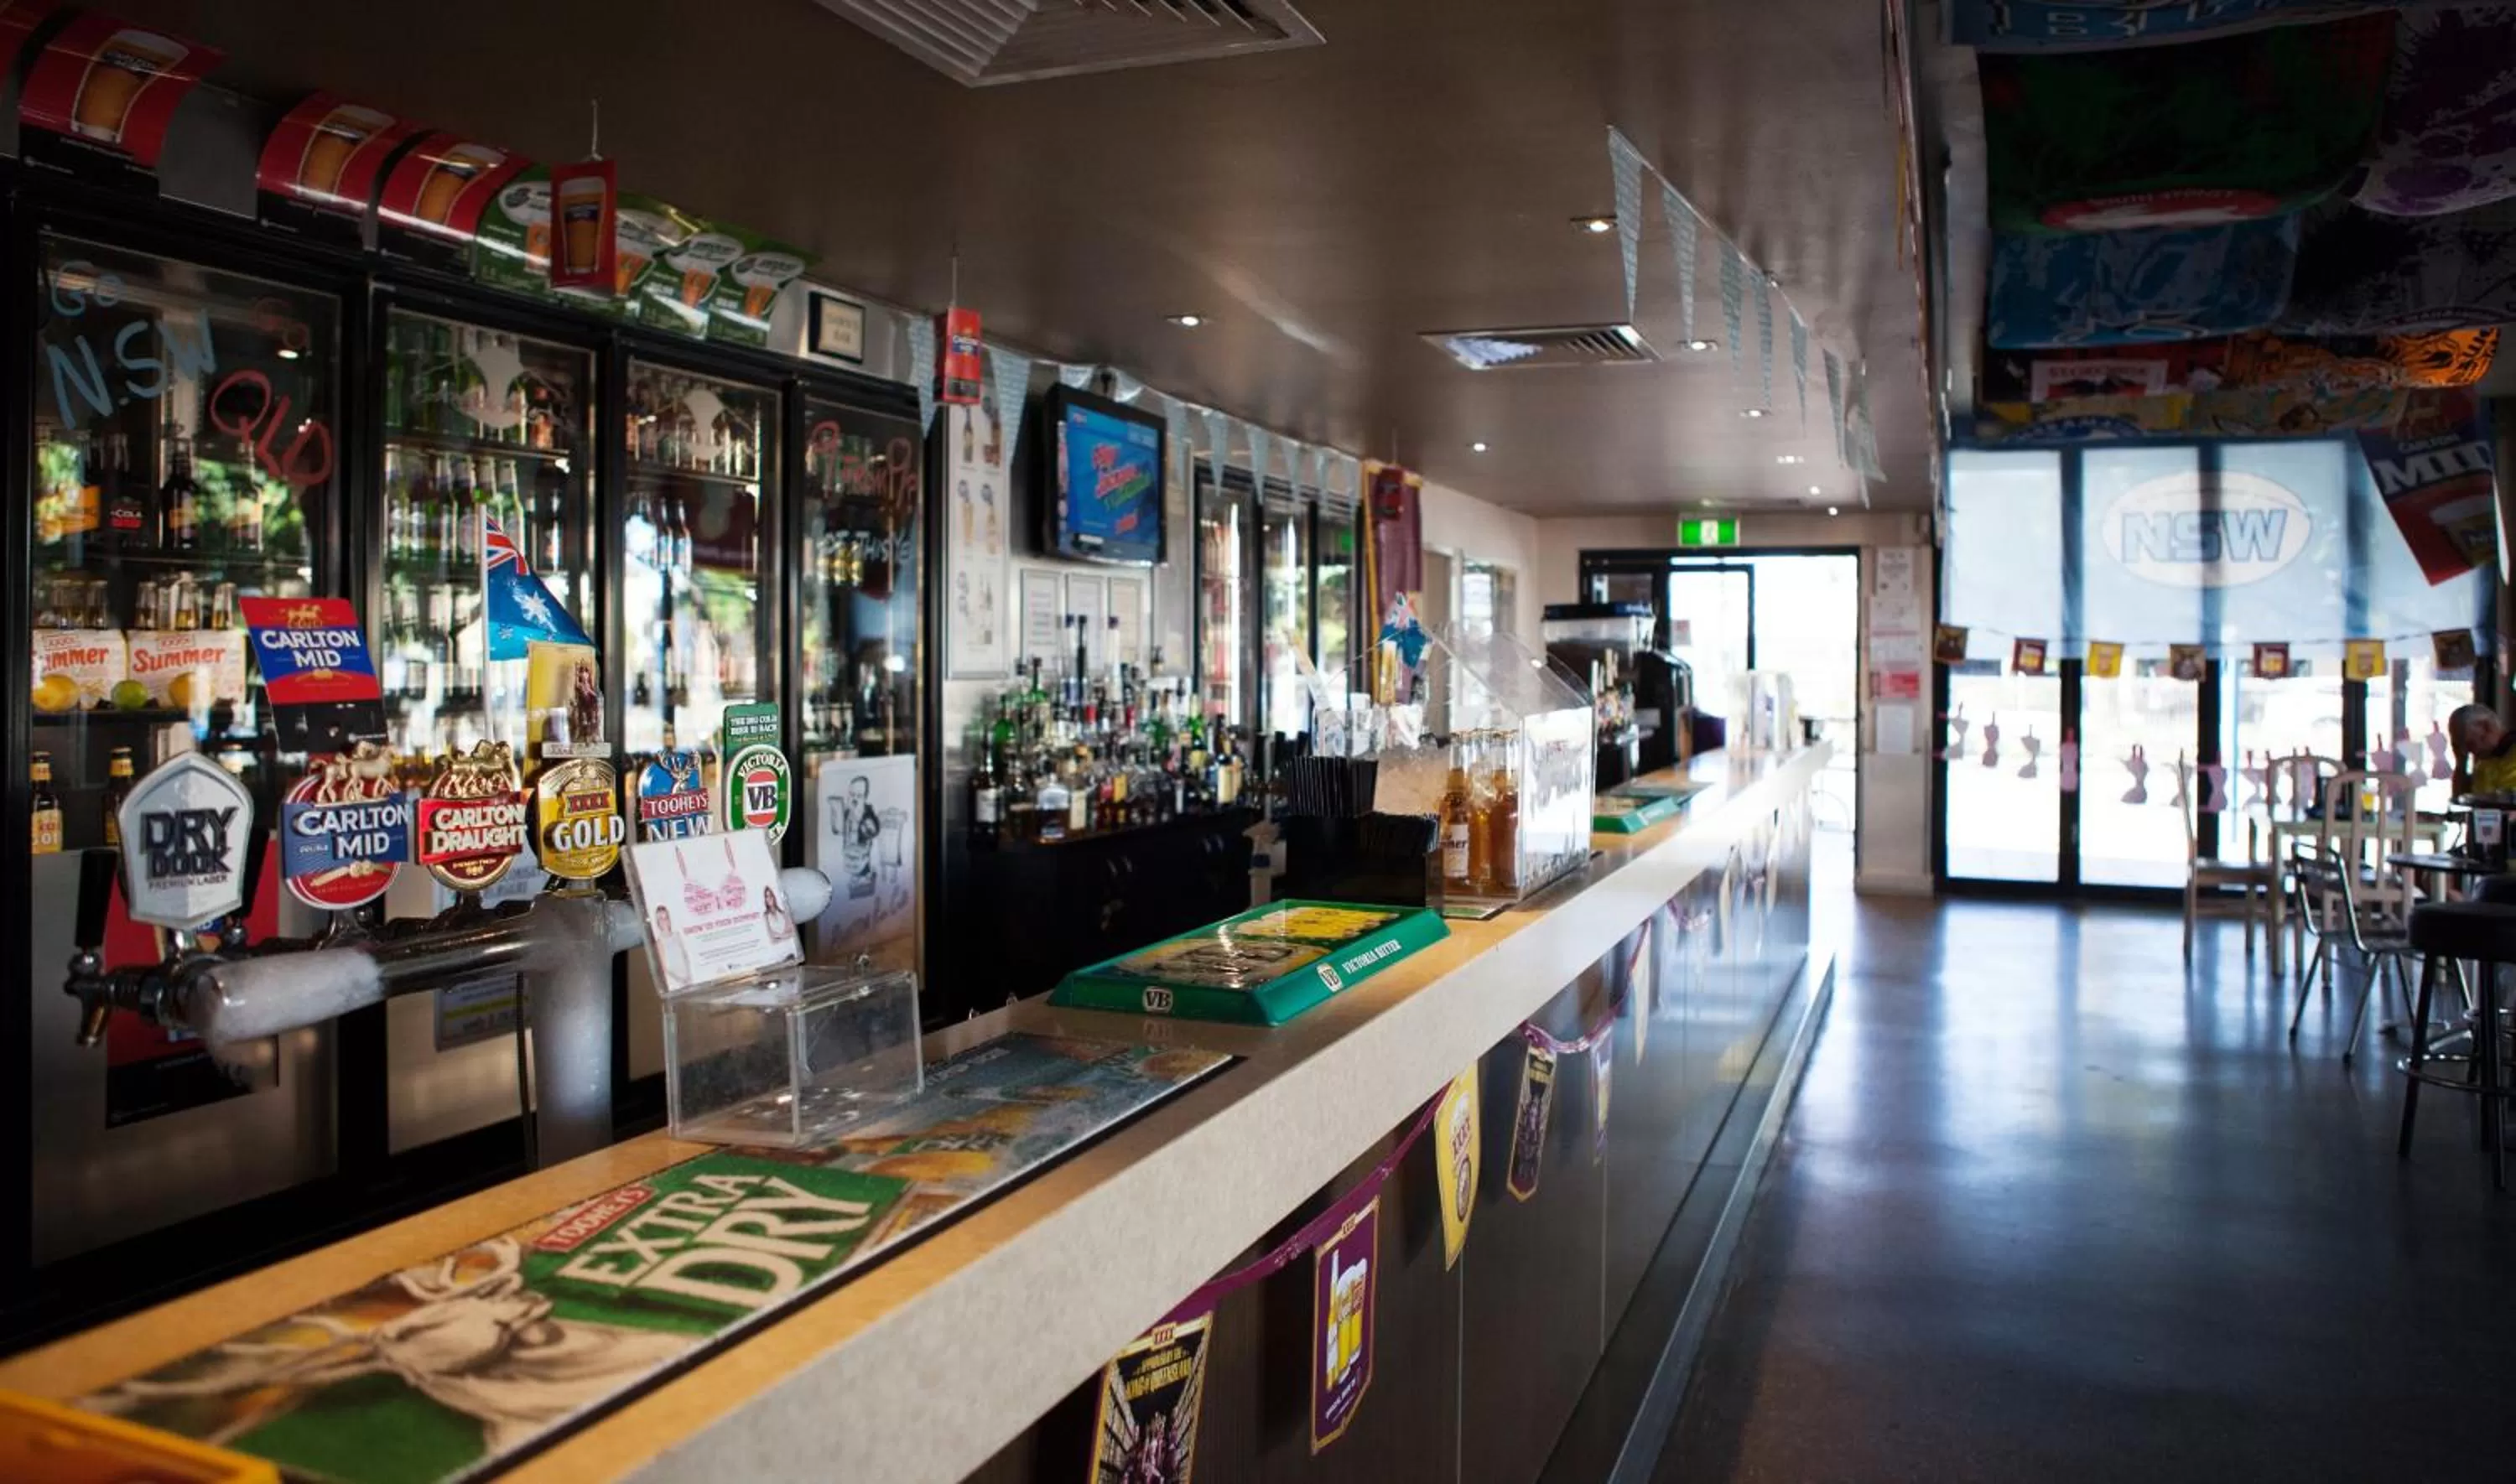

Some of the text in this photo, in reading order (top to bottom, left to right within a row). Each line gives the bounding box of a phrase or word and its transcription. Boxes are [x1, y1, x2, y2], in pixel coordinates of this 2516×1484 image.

[209, 368, 333, 485] QLD
[2121, 508, 2287, 563] NSW
[260, 630, 361, 649] CARLTON
[133, 646, 226, 673] Summer
[292, 650, 342, 667] MID
[737, 754, 787, 778] VICTORIA
[567, 791, 611, 814] XXXX
[646, 791, 709, 816] TOOHEYS
[746, 785, 777, 811] VB
[296, 803, 409, 836] CARLTON
[434, 804, 528, 830] CARLTON
[647, 814, 714, 843] NEW
[140, 807, 239, 856] DRY
[430, 824, 528, 854] DRAUGHT
[553, 814, 626, 852] GOLD
[336, 832, 390, 859] MID
[1341, 949, 1378, 974] VICTORIA
[1146, 989, 1173, 1009] VB
[545, 1185, 648, 1247] TOOHEYS
[555, 1174, 766, 1287] EXTRA
[631, 1175, 872, 1308] DRY
